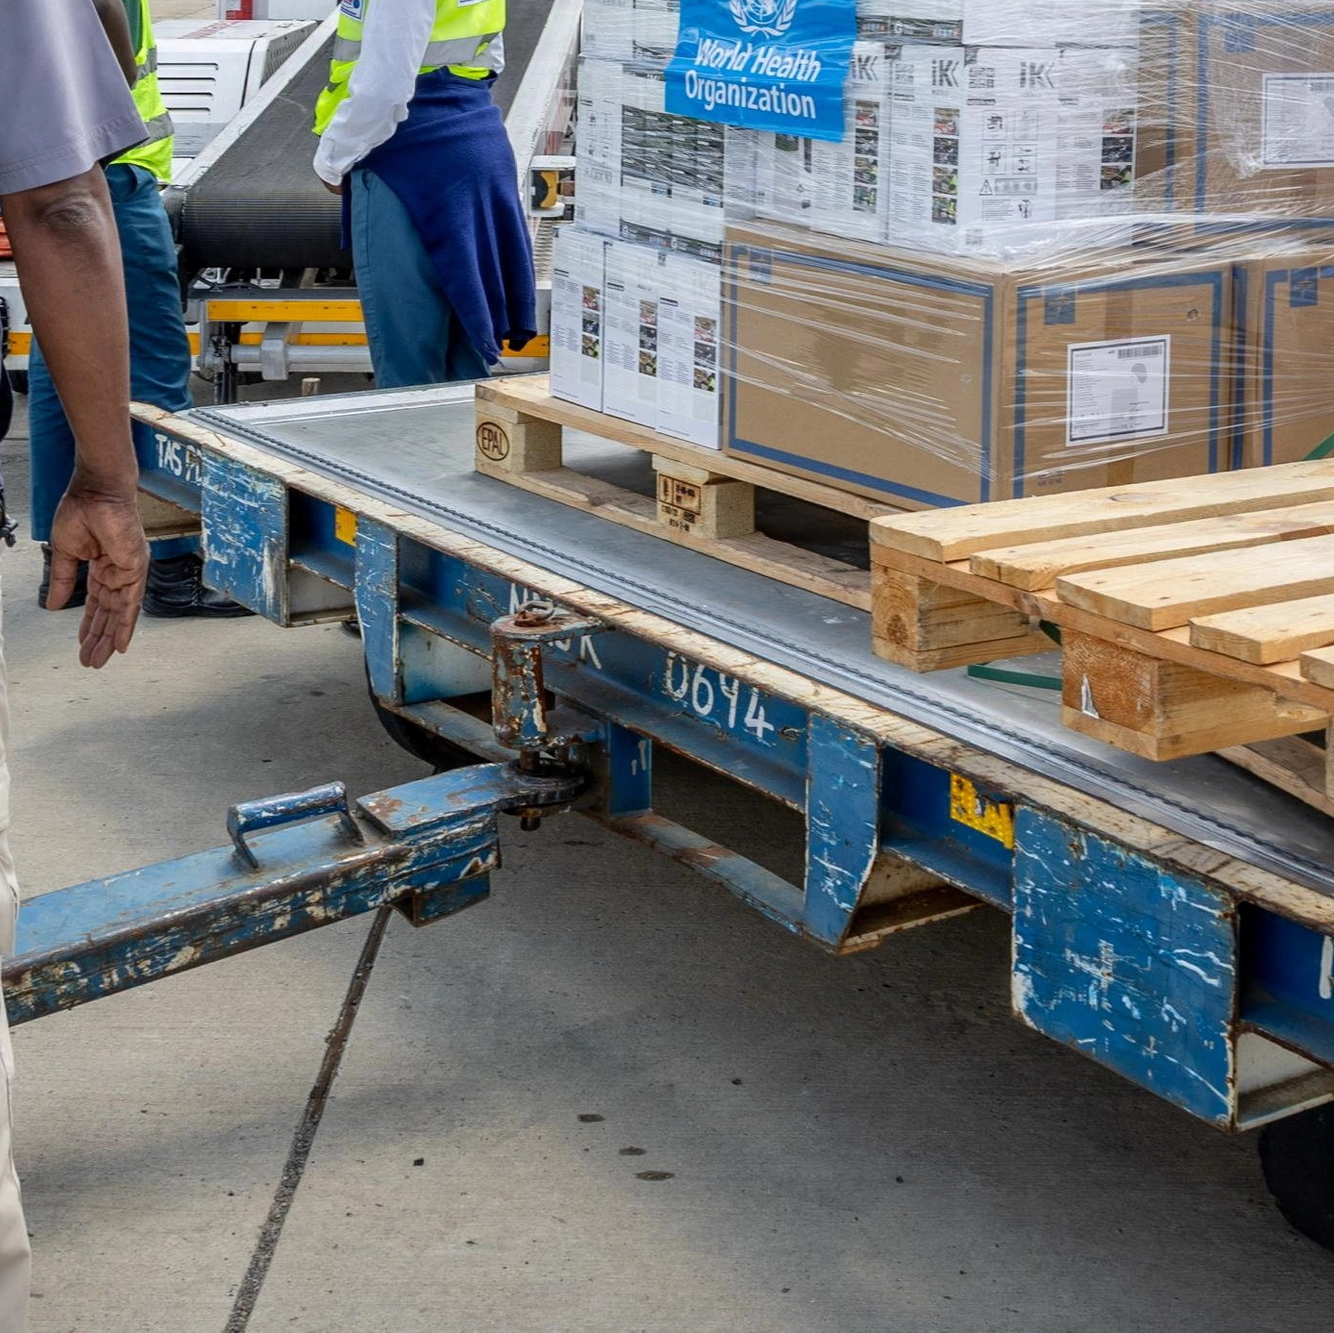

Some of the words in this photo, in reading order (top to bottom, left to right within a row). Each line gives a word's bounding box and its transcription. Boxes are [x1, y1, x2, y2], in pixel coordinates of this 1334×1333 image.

[695, 37, 749, 70] World
[751, 44, 822, 83] Health
[685, 69, 817, 121] Organization
[481, 427, 504, 456] EPAL
